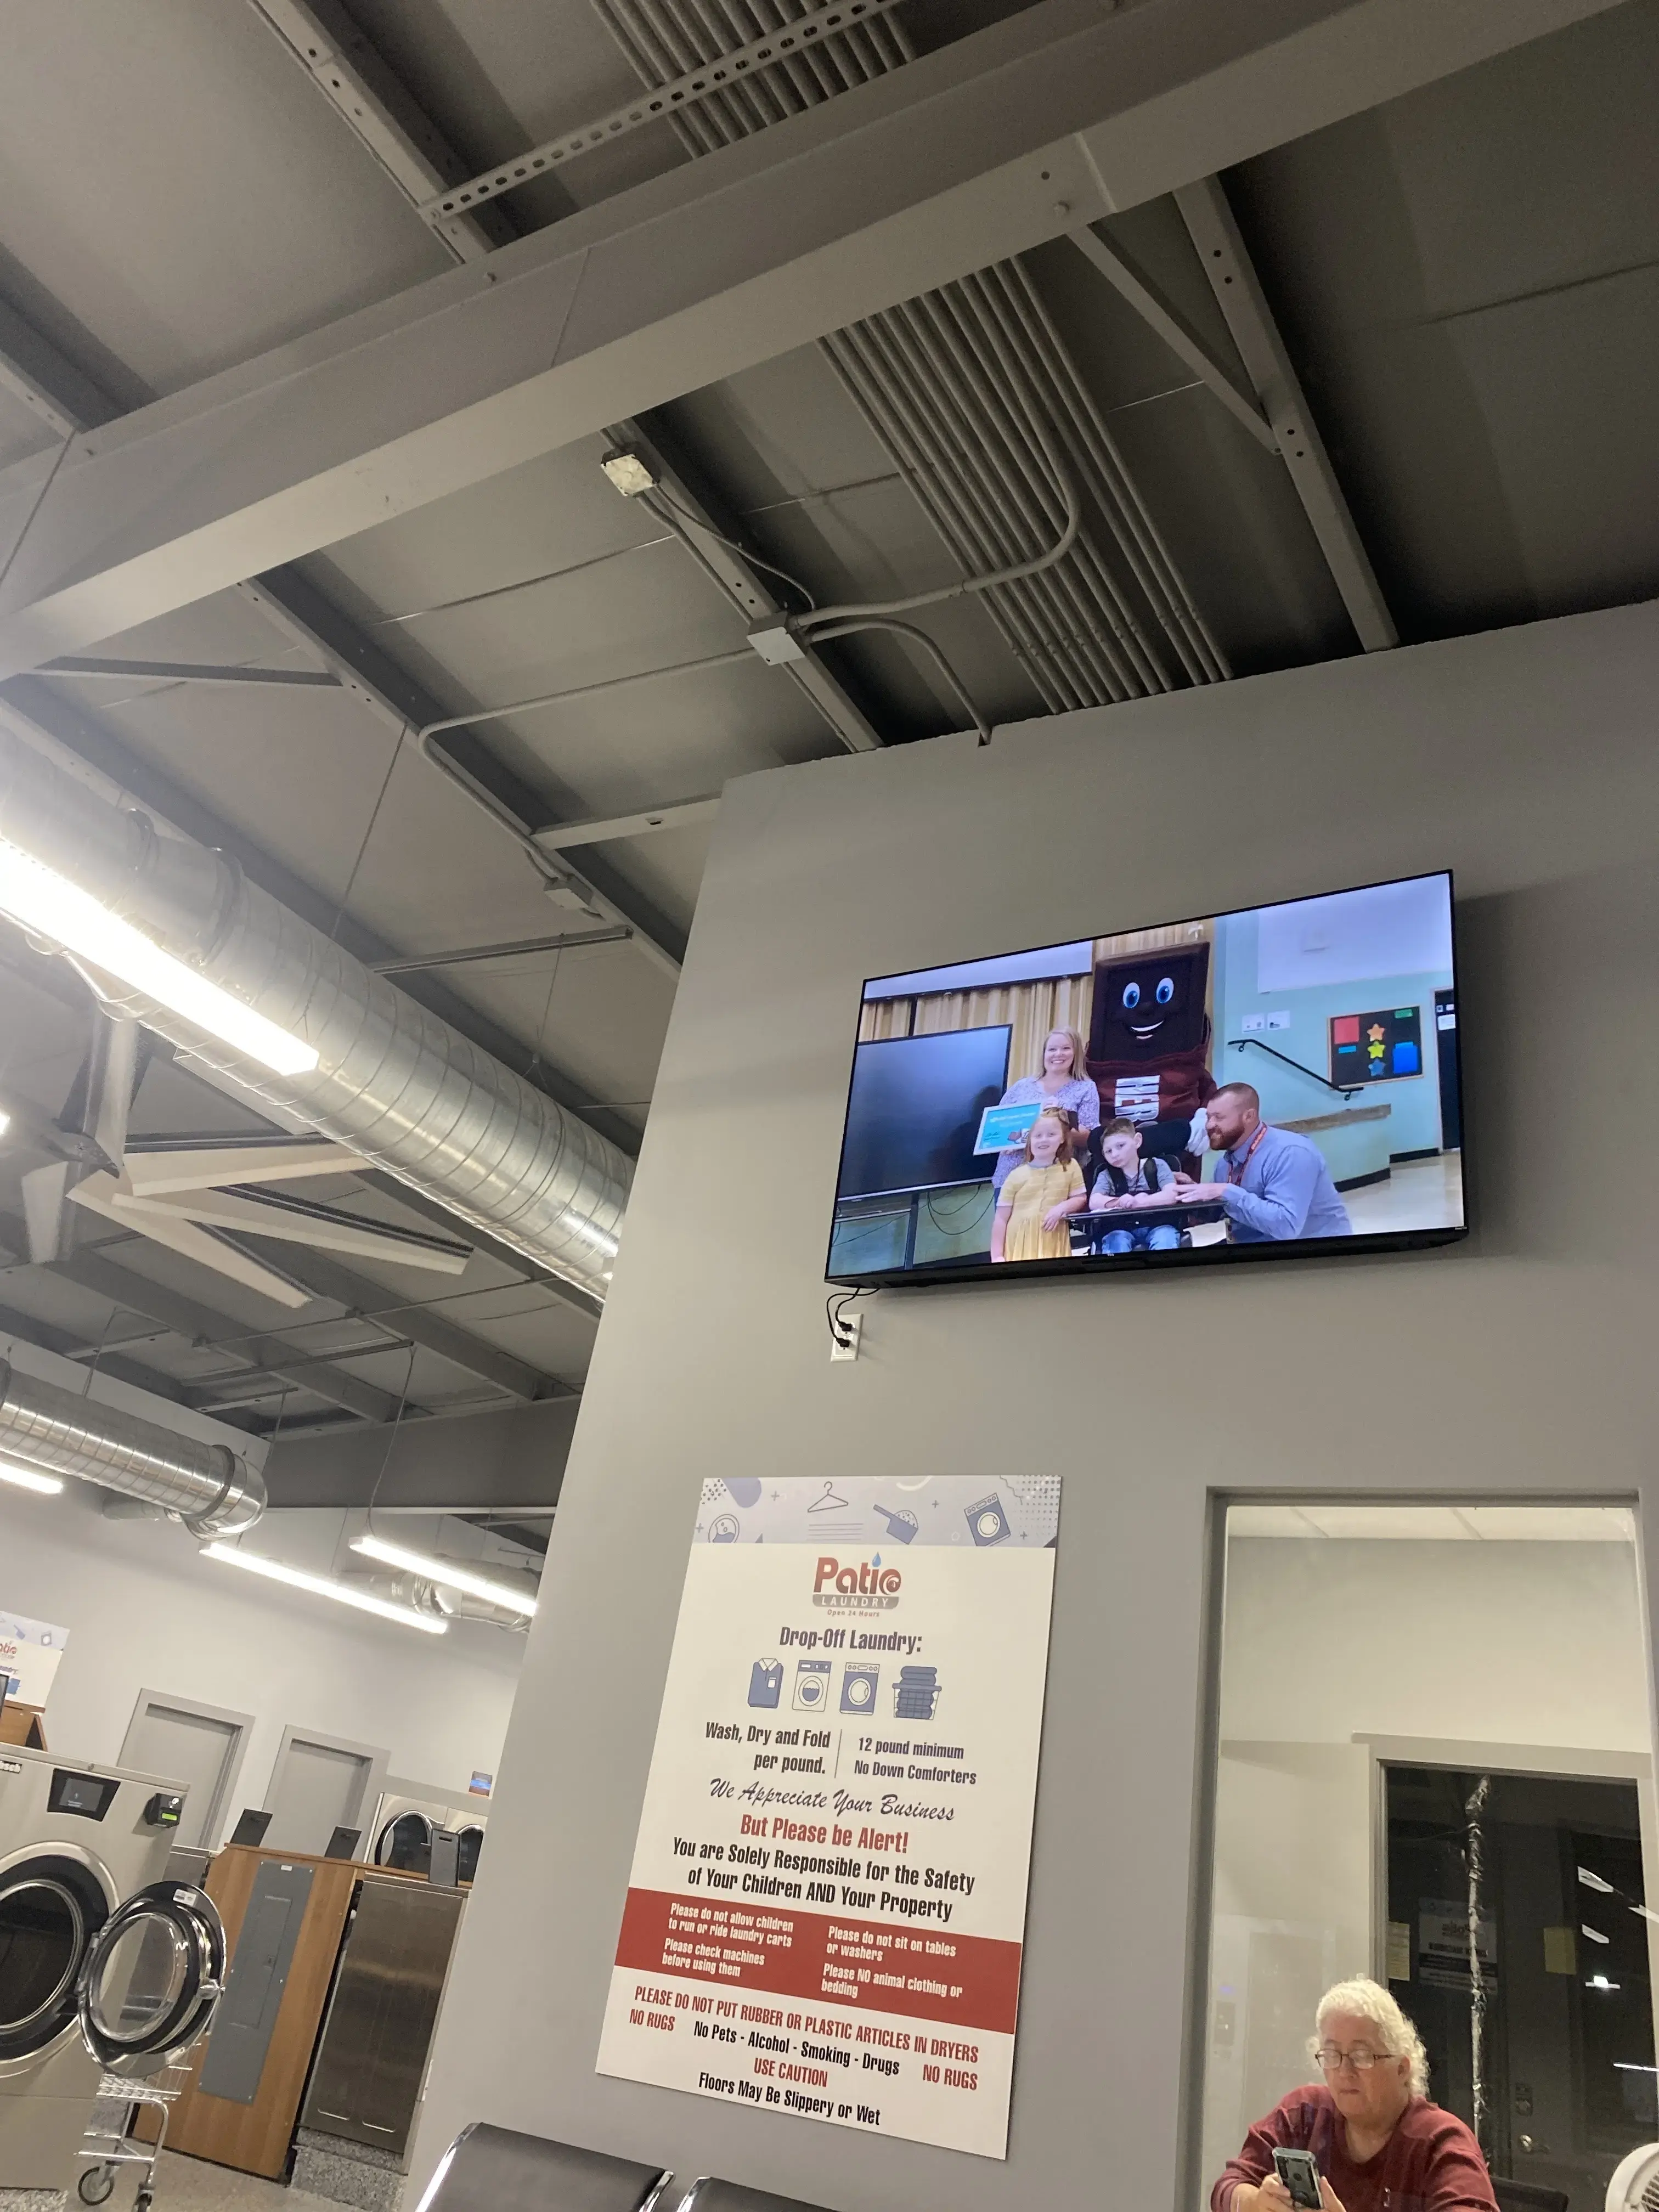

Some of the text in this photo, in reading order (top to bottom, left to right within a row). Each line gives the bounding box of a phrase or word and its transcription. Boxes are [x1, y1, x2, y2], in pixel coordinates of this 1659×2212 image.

[813, 1551, 901, 1595] Patio
[821, 1596, 889, 1608] LAUNDRY
[780, 1627, 922, 1655] Drop-Off Laundry:
[706, 1722, 831, 1748] Wash, Dry and Fold
[859, 1737, 963, 1759] 12 pound minimum
[754, 1754, 825, 1774] per pound.
[855, 1760, 976, 1784] No Down Comforters
[710, 1778, 953, 1820] We Appreciate Your Business
[741, 1814, 908, 1853] But Please be Alert!
[674, 1837, 975, 1895] You are Solely Responsible for the Safety
[689, 1867, 952, 1922] of Your Children AND Your Property
[669, 1917, 792, 1946] to run or ride laundry carts
[670, 1903, 793, 1932] Please do not allow children
[665, 1938, 764, 1965] Please check machines
[827, 1943, 883, 1961] or washers
[828, 1926, 956, 1956] Please do not sit on tables
[662, 1953, 740, 1977] before using them
[821, 1979, 858, 1998] bedding
[823, 1963, 962, 1997] Please NO animal clothing or
[630, 2009, 675, 2031] NO RUGS
[635, 1986, 978, 2063] PLEASE DO NOT PUT RUBBER OR PLASTIC ARTICLES IN DRYERS
[694, 2021, 708, 2037] No
[712, 2024, 736, 2042] Pets
[748, 2032, 789, 2053] Alcohol
[801, 2041, 850, 2067] Smoking
[862, 2053, 899, 2076] Drugs
[754, 2058, 827, 2087] USE CAUTION
[923, 2064, 978, 2090] NO RUGS
[699, 2072, 880, 2125] Floors May Be Slippery or Wet
